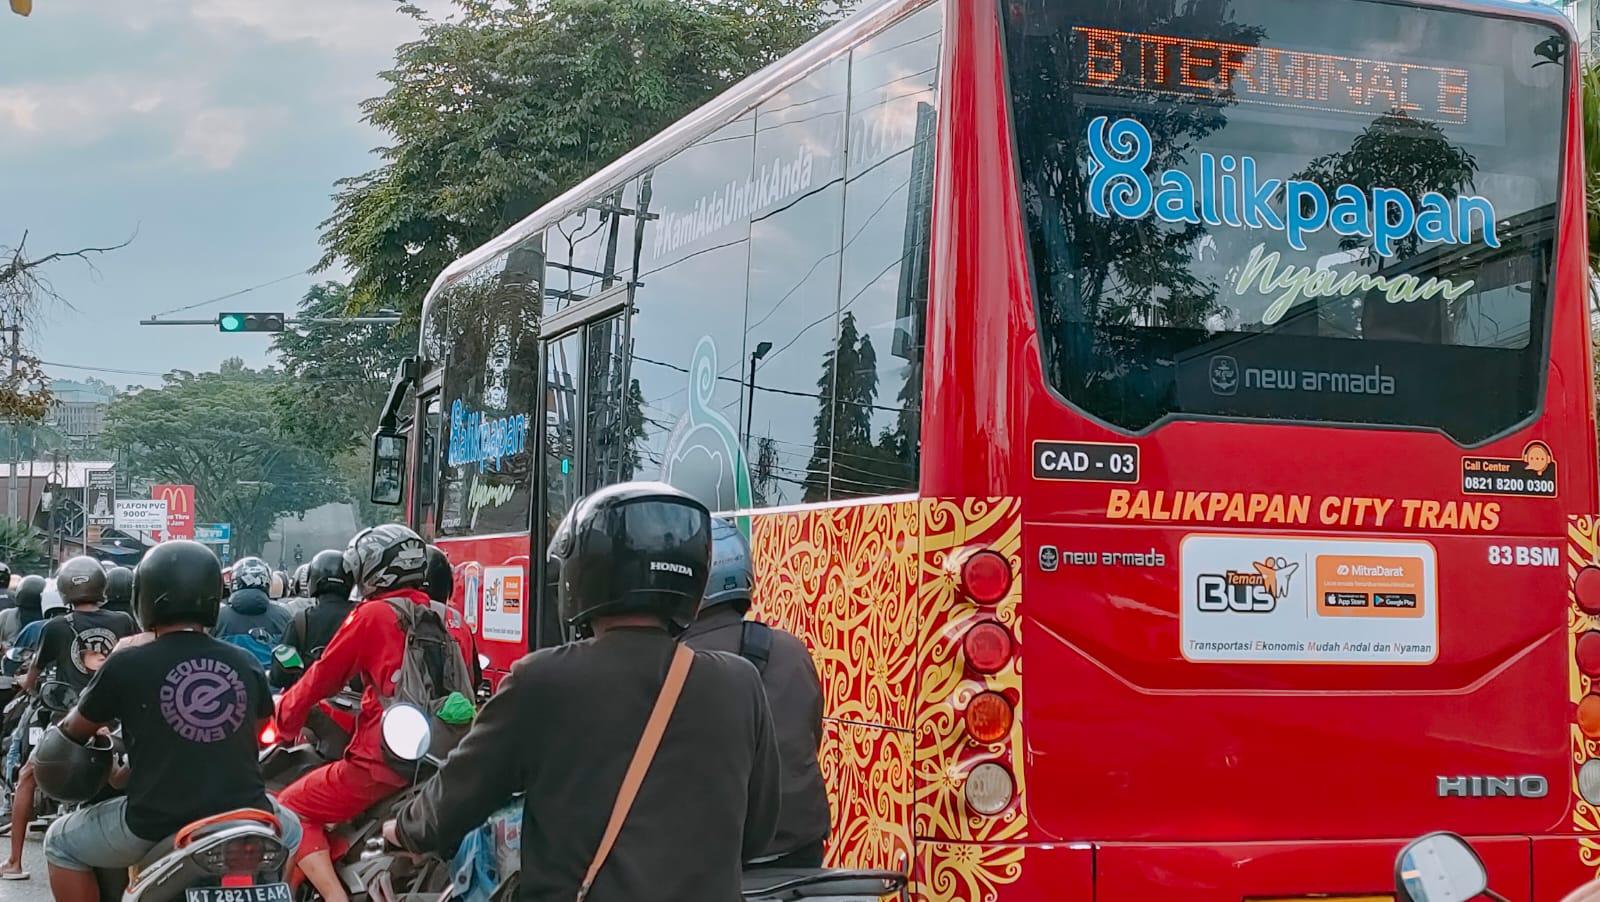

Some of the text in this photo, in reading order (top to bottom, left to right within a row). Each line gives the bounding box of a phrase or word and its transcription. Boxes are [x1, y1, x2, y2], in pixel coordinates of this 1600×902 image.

[1142, 36, 1424, 110] TERMINAL
[1088, 116, 1500, 257] Balikpapan
[653, 145, 813, 260] #KamiAdaUntukAnda
[1235, 242, 1475, 325] Nyaman
[1245, 365, 1395, 395] new armada
[1040, 450, 1089, 473] CAD
[1109, 453, 1134, 474] 03
[1464, 460, 1510, 473] Call Center
[1465, 476, 1555, 492] 0821 8200 0300
[1106, 488, 1501, 531] BALIKPAPAN CITY TRANS
[1063, 547, 1166, 567] new armada
[1488, 545, 1560, 567] 83 BSM
[650, 561, 693, 577] HONDA
[1227, 572, 1264, 585] Teman
[1352, 565, 1404, 577] MitraDarat
[1189, 640, 1432, 655] Transportasi Ekonomis Mudah Andal dan Nyaman
[165, 658, 248, 733] EQUIPMENT
[160, 685, 227, 743] ENDURO
[1437, 775, 1549, 798] HINO
[214, 889, 251, 902] 2821
[256, 885, 289, 902] EAK
